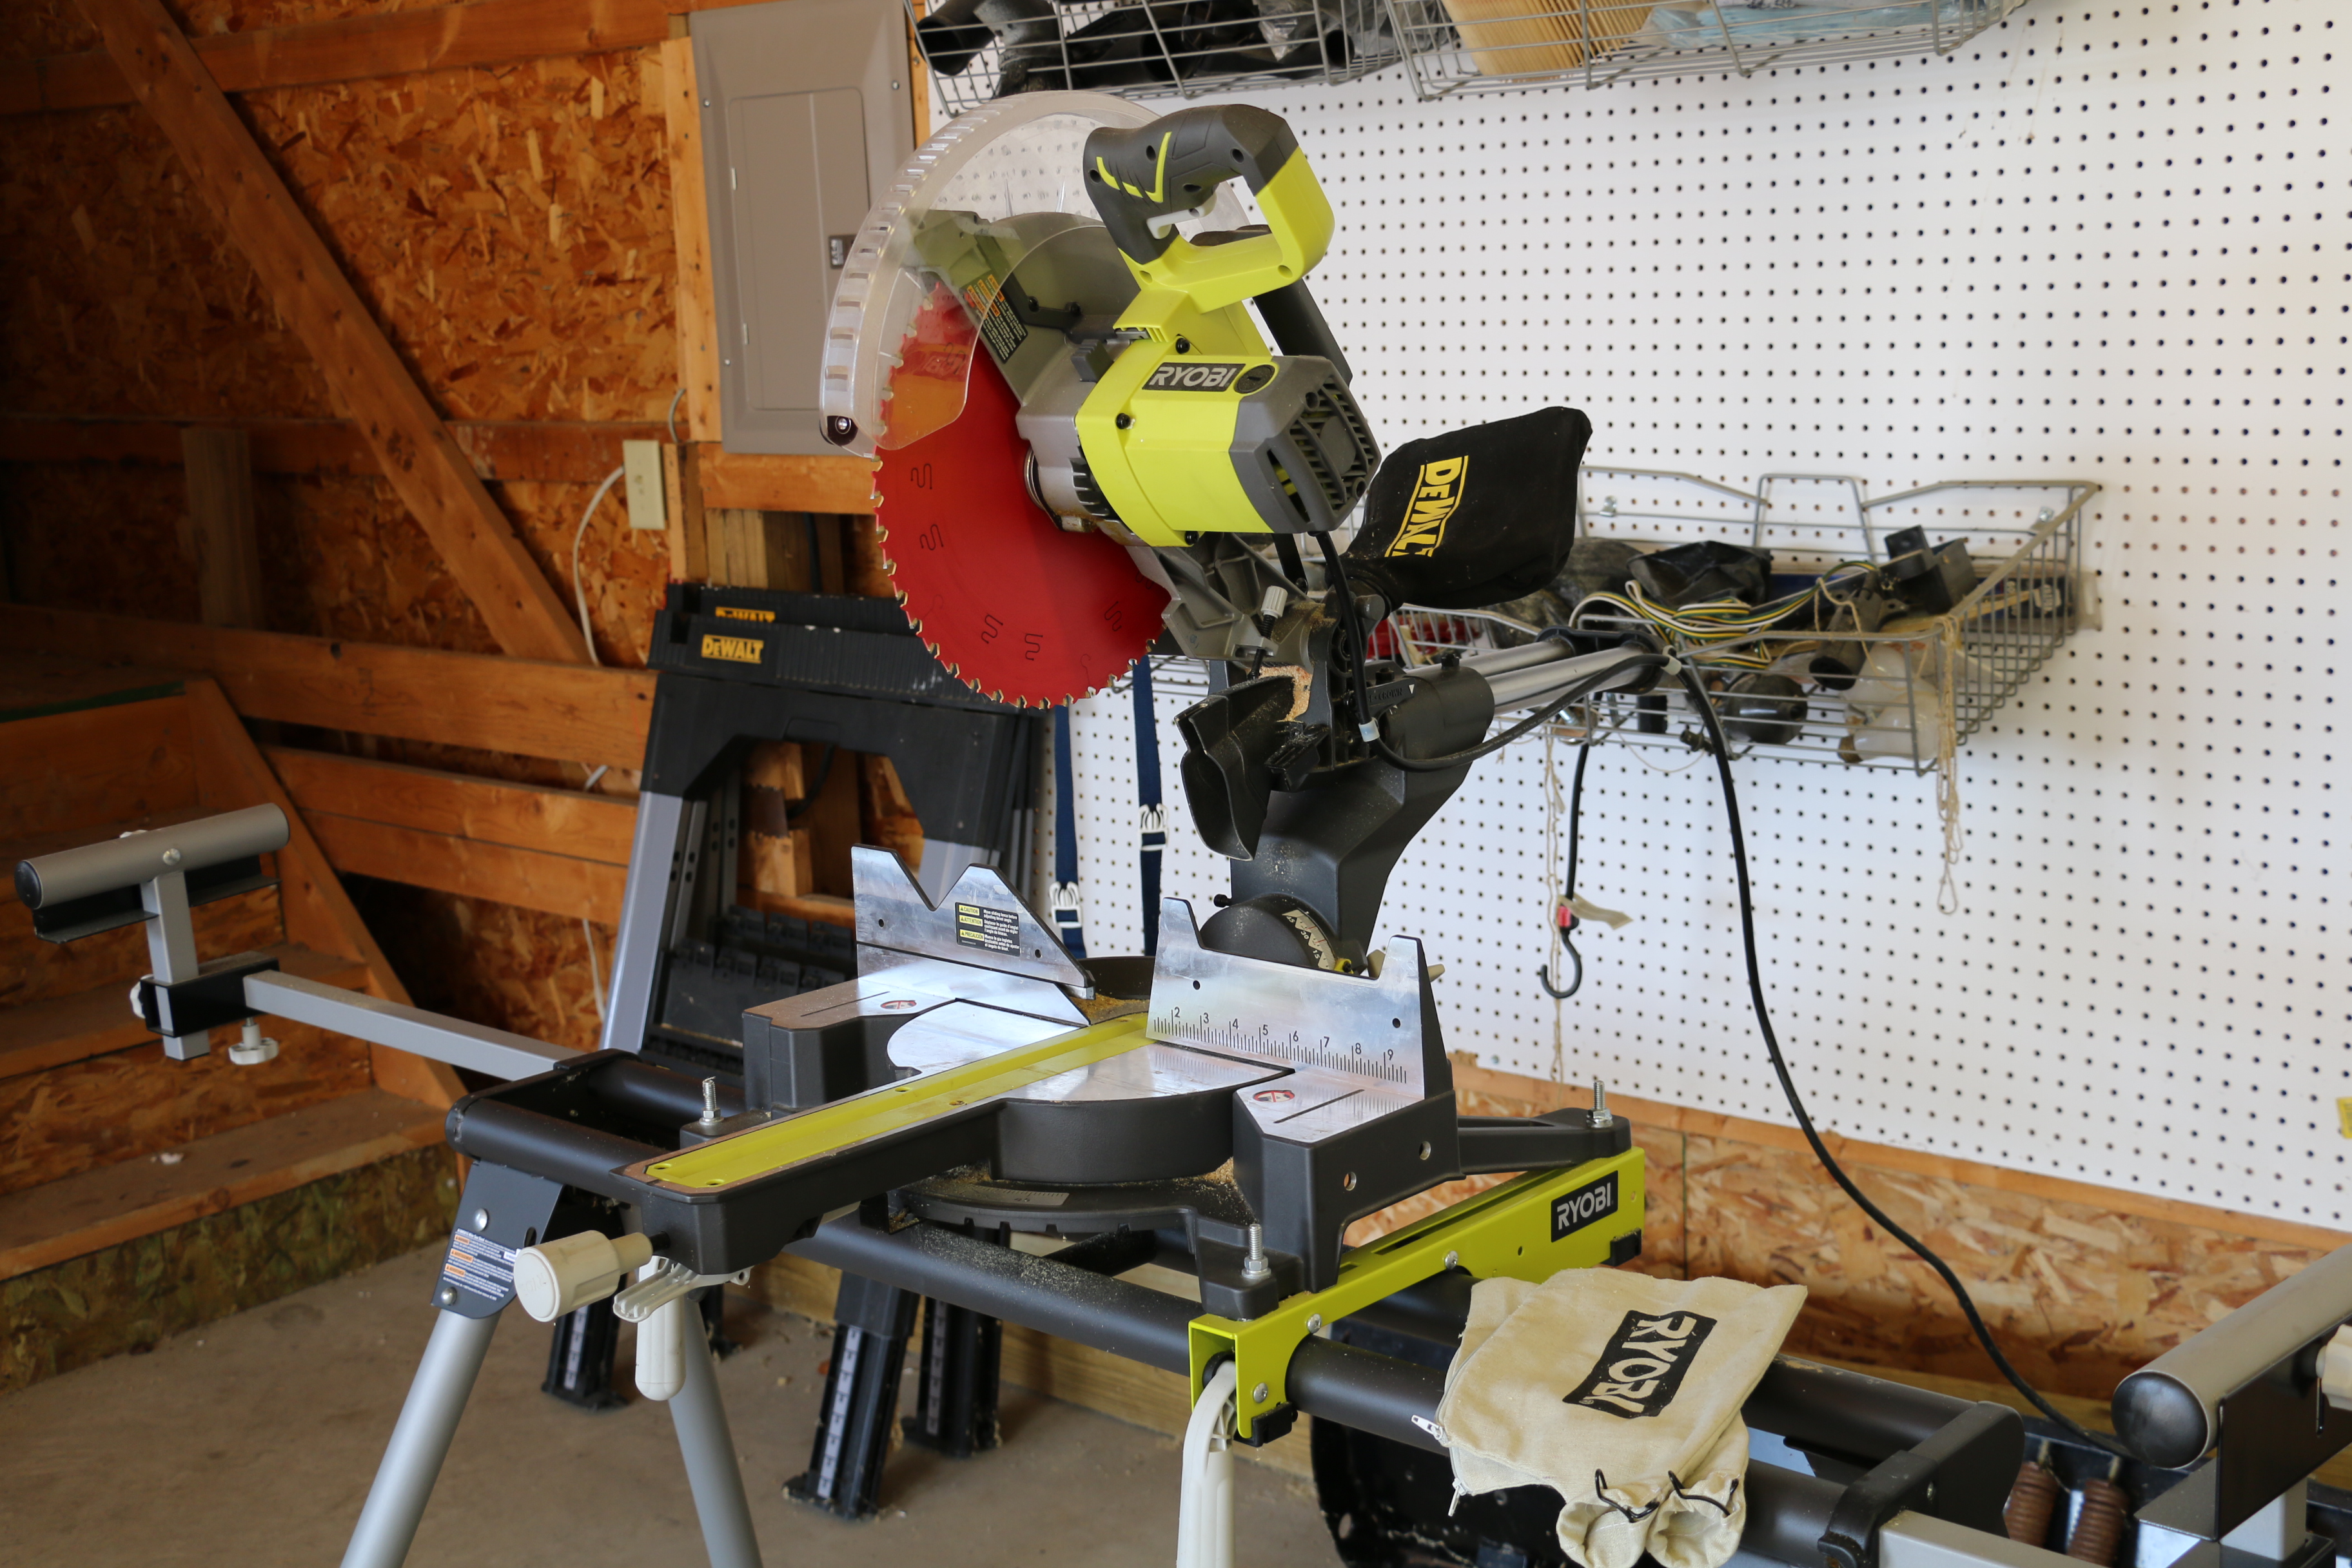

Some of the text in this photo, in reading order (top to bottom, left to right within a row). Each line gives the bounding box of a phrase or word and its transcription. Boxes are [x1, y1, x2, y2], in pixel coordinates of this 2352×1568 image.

[1148, 366, 1237, 387] RYOBI
[701, 635, 763, 663] DEWALT
[1300, 931, 1309, 939] 30
[1313, 950, 1320, 959] 15
[1173, 1006, 1394, 1061] 2 3 4 5 6 7 8 9
[1557, 1182, 1611, 1230] RYOBI
[1583, 1315, 1698, 1413] RYOBI
